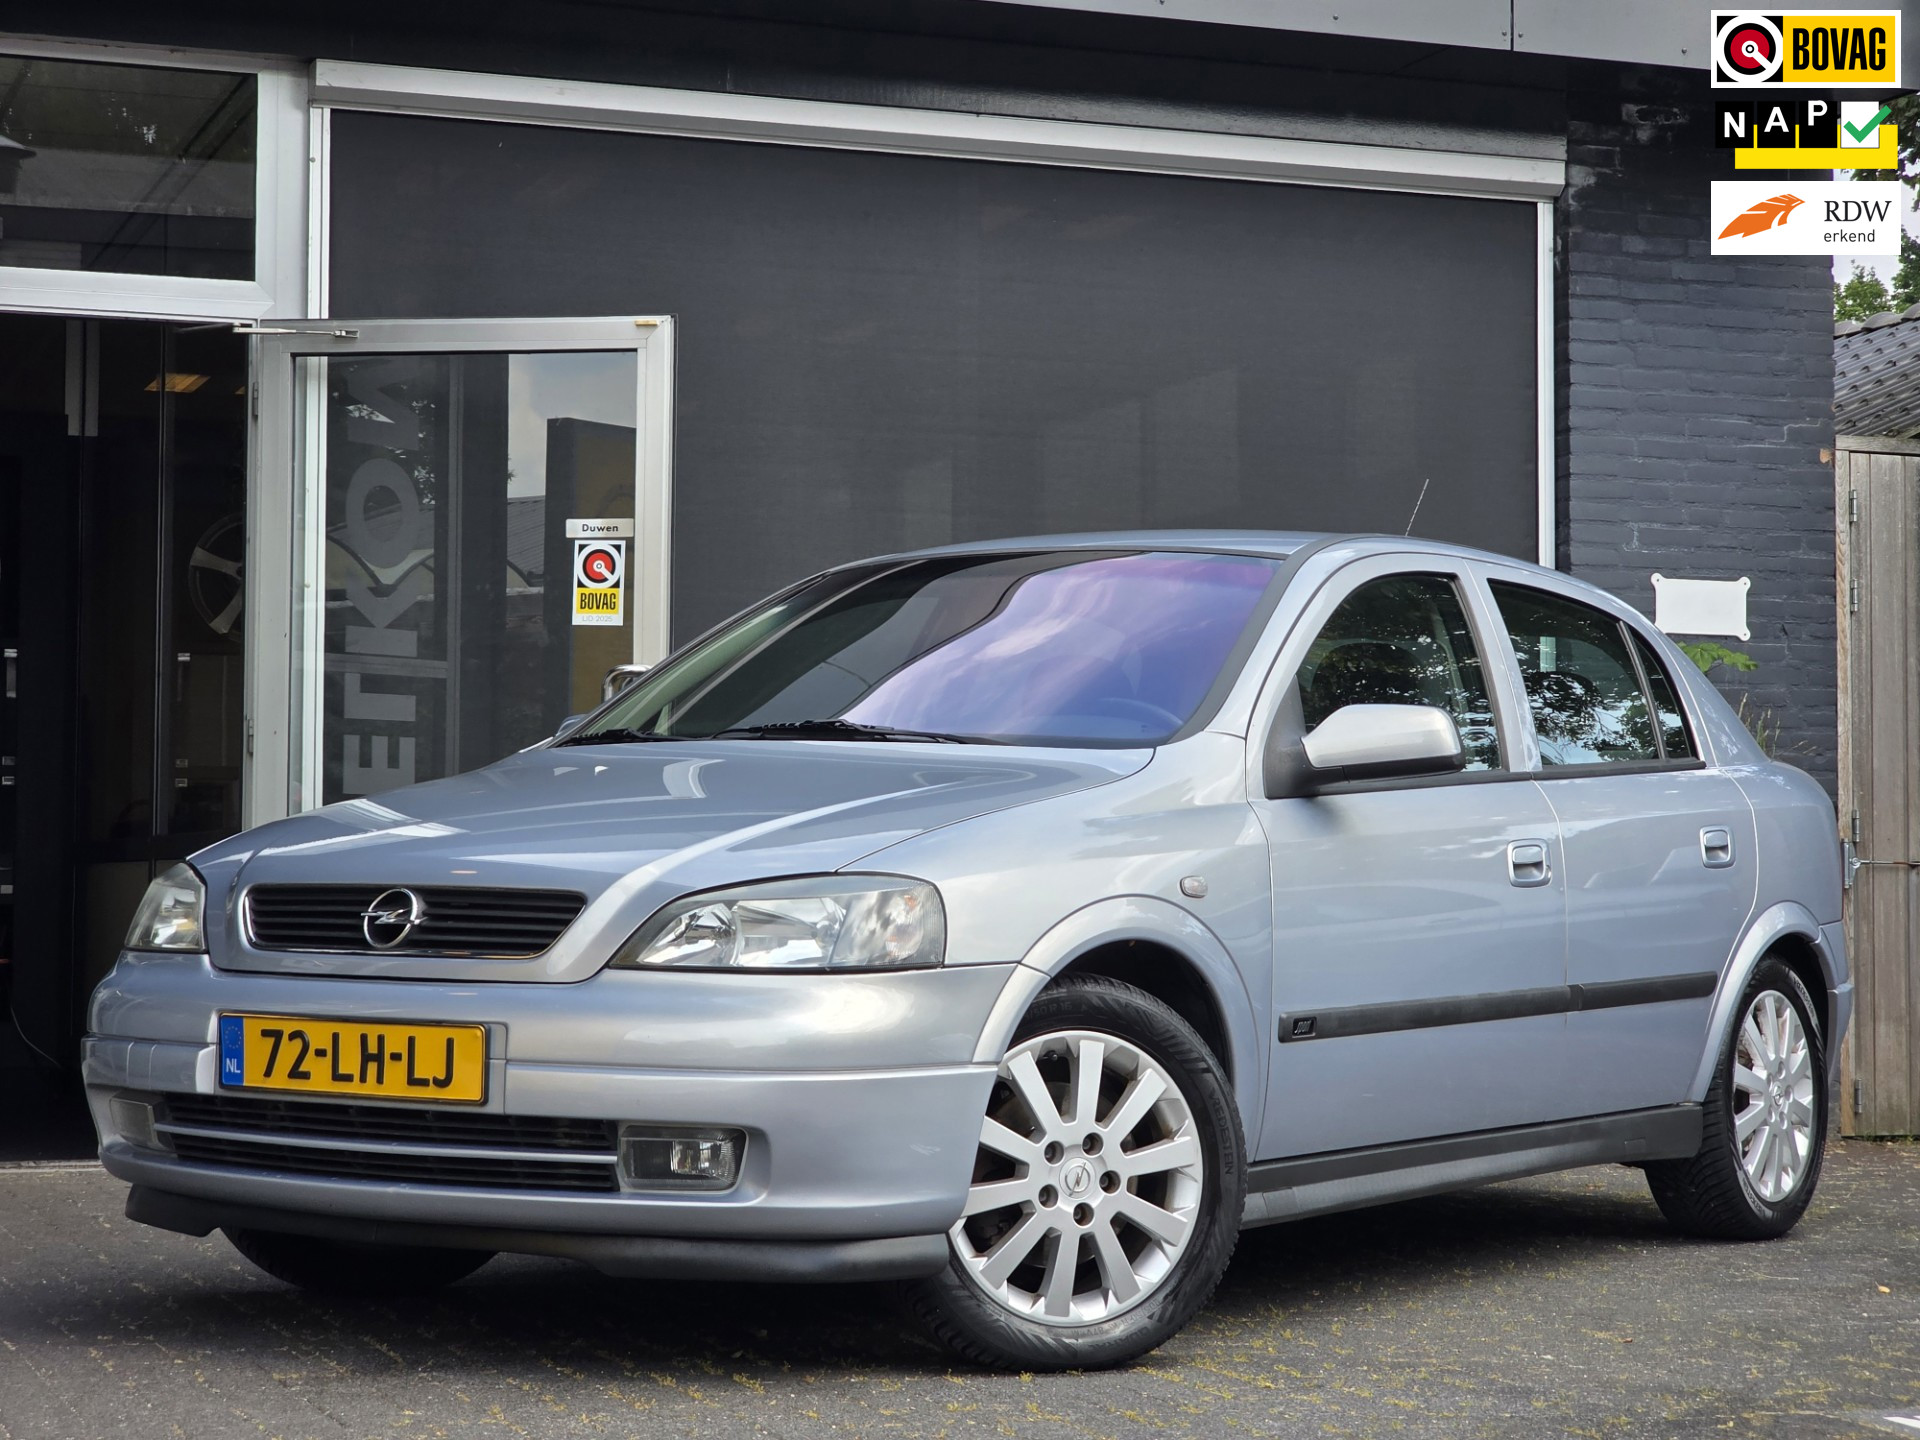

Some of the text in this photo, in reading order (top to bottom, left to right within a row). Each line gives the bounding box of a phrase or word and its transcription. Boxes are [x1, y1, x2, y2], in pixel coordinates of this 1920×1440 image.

[581, 523, 619, 532] Duwen
[579, 592, 617, 610] BOVAG
[225, 1058, 241, 1073] NL
[260, 1028, 455, 1088] 72-LH-LJ
